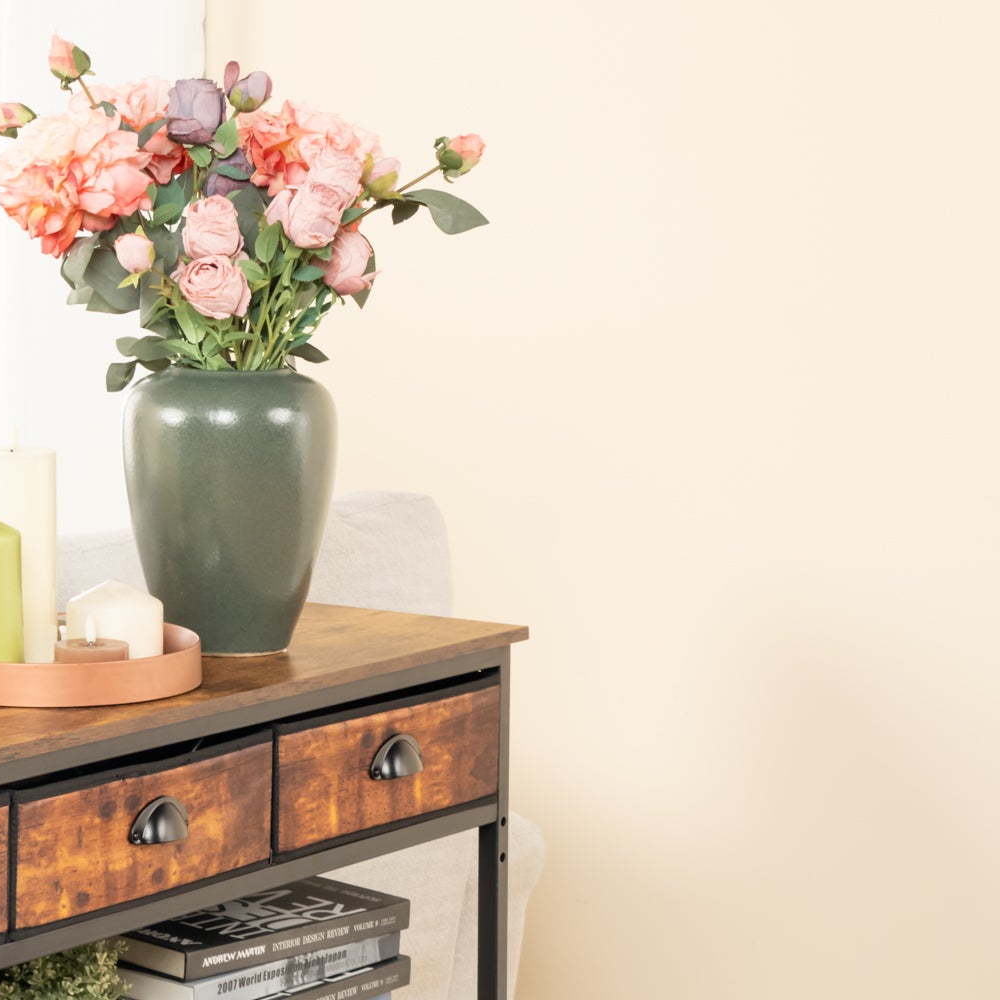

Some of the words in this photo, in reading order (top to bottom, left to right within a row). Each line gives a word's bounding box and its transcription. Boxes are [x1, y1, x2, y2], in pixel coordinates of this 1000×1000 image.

[202, 952, 236, 968] ANDREW
[236, 945, 266, 960] MARTIN
[272, 937, 301, 952] INTERIOR
[302, 931, 325, 945] DESIGN
[326, 926, 350, 939] REVIEW
[353, 921, 374, 932] VOLUME
[217, 979, 238, 995] 2007
[238, 971, 262, 989] World
[337, 986, 358, 1000] REVIEW
